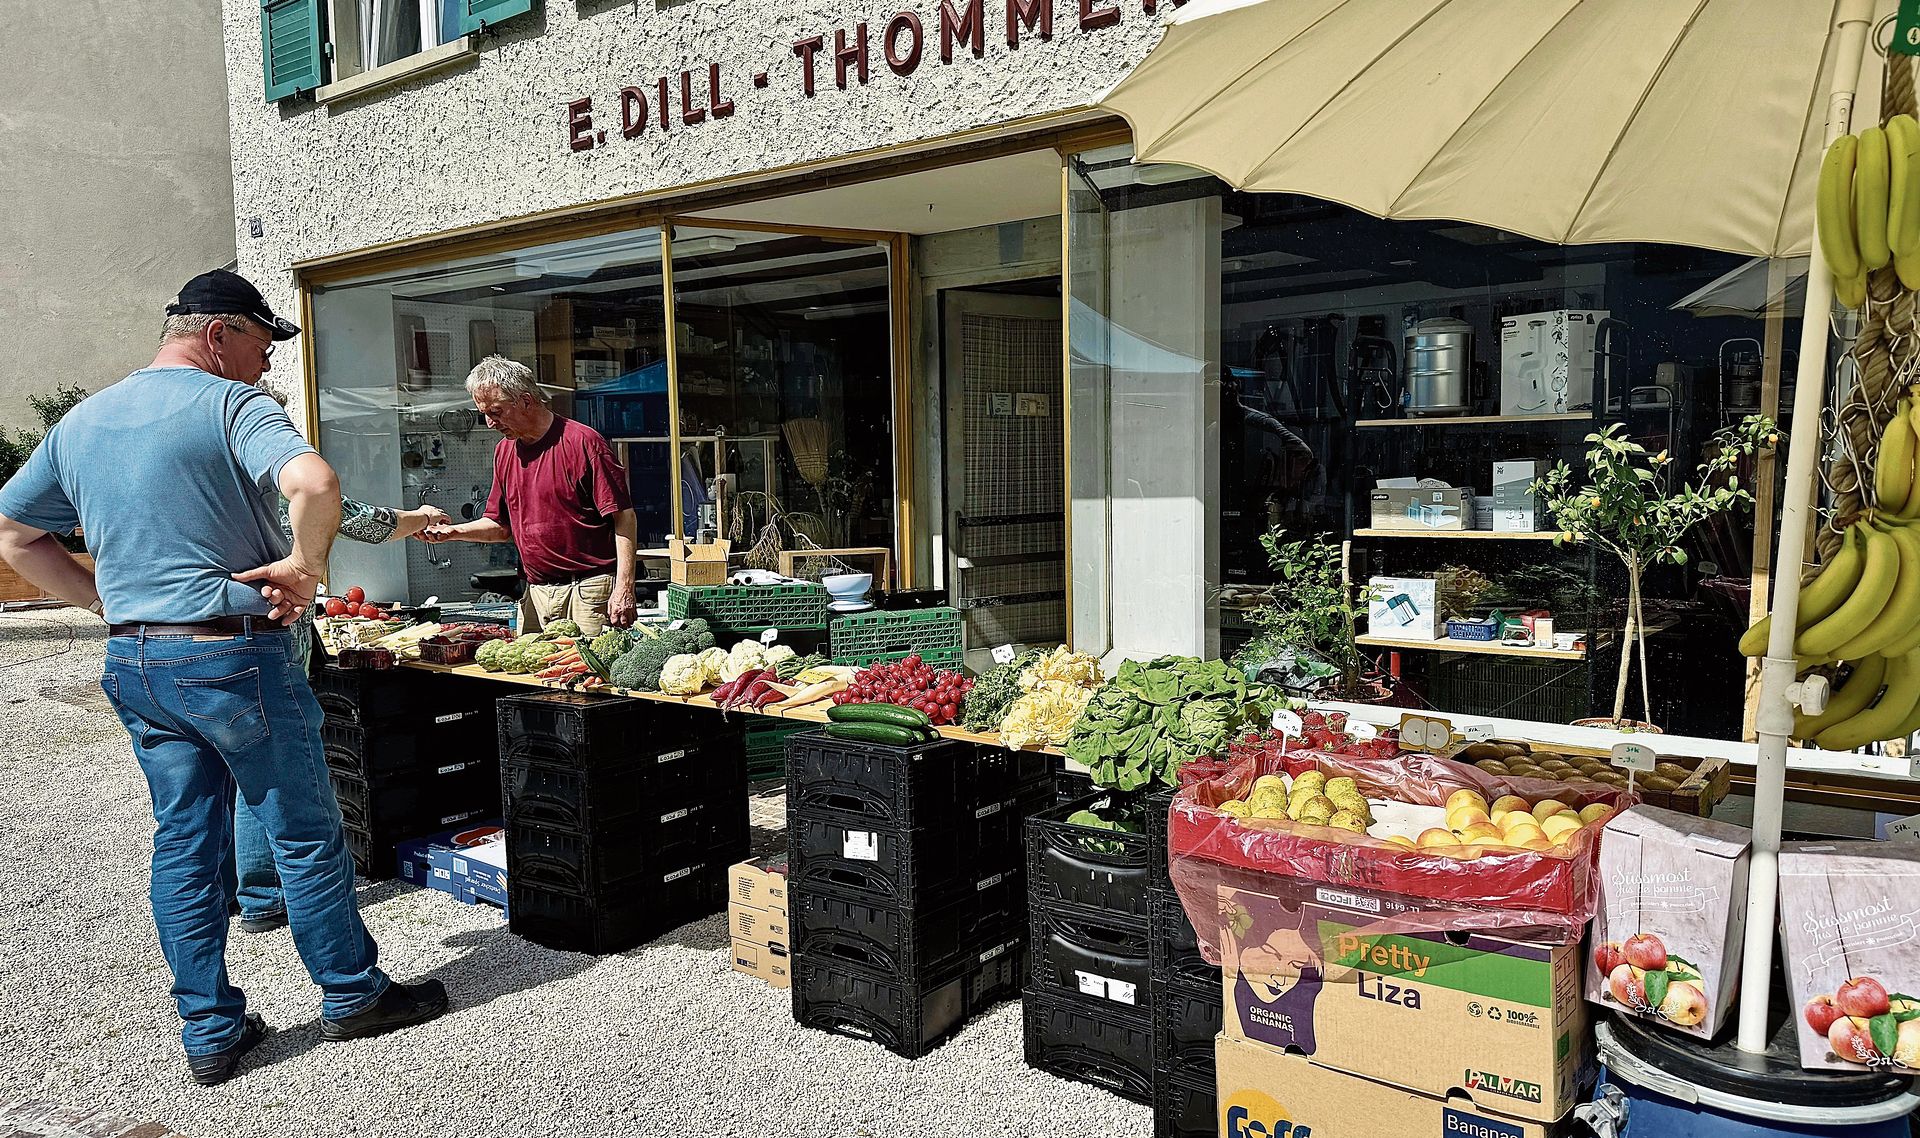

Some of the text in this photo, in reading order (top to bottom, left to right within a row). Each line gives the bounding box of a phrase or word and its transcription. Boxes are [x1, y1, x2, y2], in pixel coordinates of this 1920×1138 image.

[568, 98, 605, 151] E.
[621, 63, 735, 138] DILL
[792, 0, 1187, 97] THOMM
[1803, 895, 1895, 935] Süssmost
[1338, 933, 1431, 978] Pretty
[1357, 971, 1421, 1010] Liza
[1249, 1005, 1292, 1024] ORGANIC
[1250, 1014, 1294, 1032] BANANAS
[1506, 1009, 1535, 1024] 100%
[1467, 1068, 1541, 1100] PALMAR
